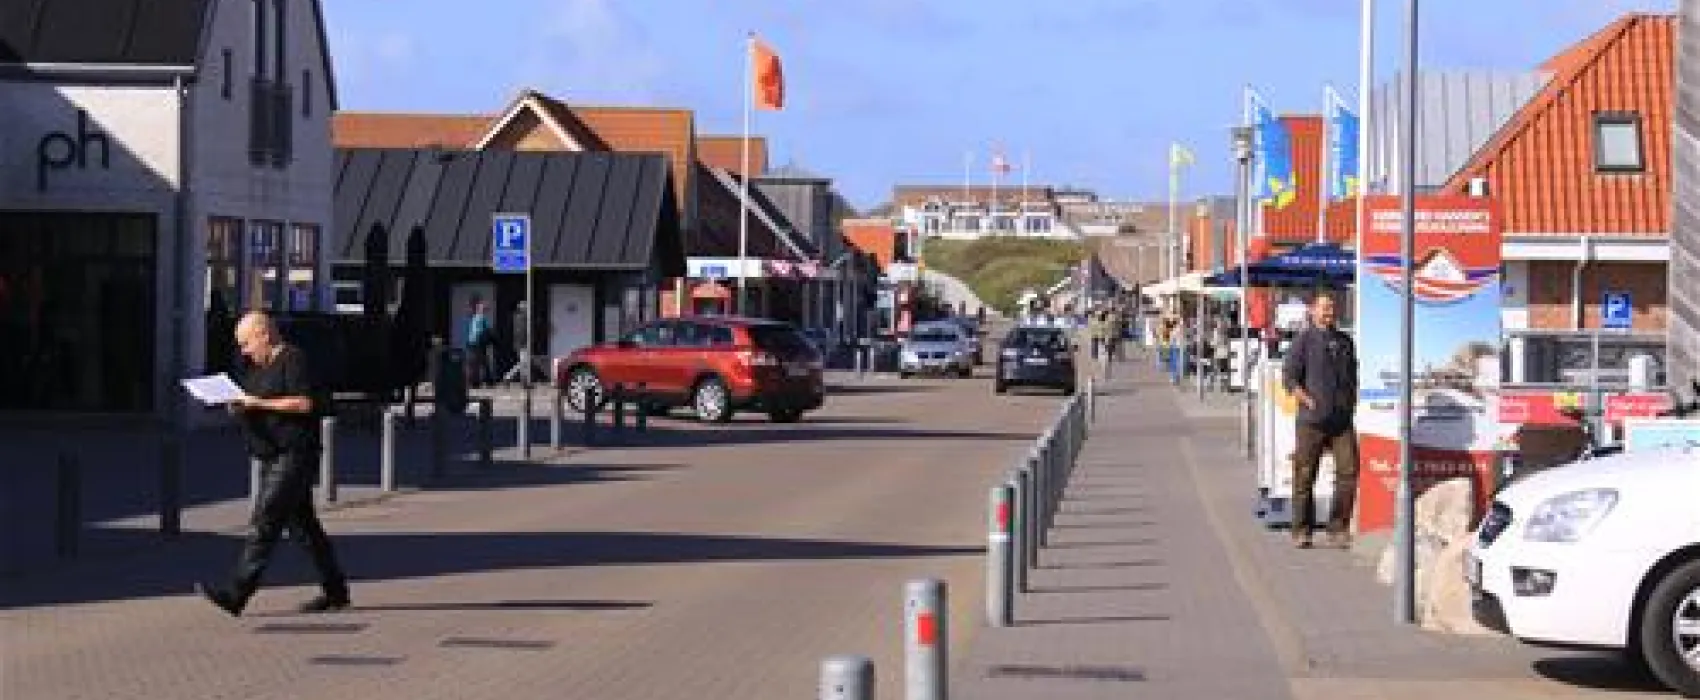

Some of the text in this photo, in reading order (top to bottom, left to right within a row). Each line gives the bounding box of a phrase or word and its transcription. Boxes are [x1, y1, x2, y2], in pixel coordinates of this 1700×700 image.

[37, 109, 109, 192] ph
[499, 221, 522, 247] P
[1608, 295, 1626, 319] P
